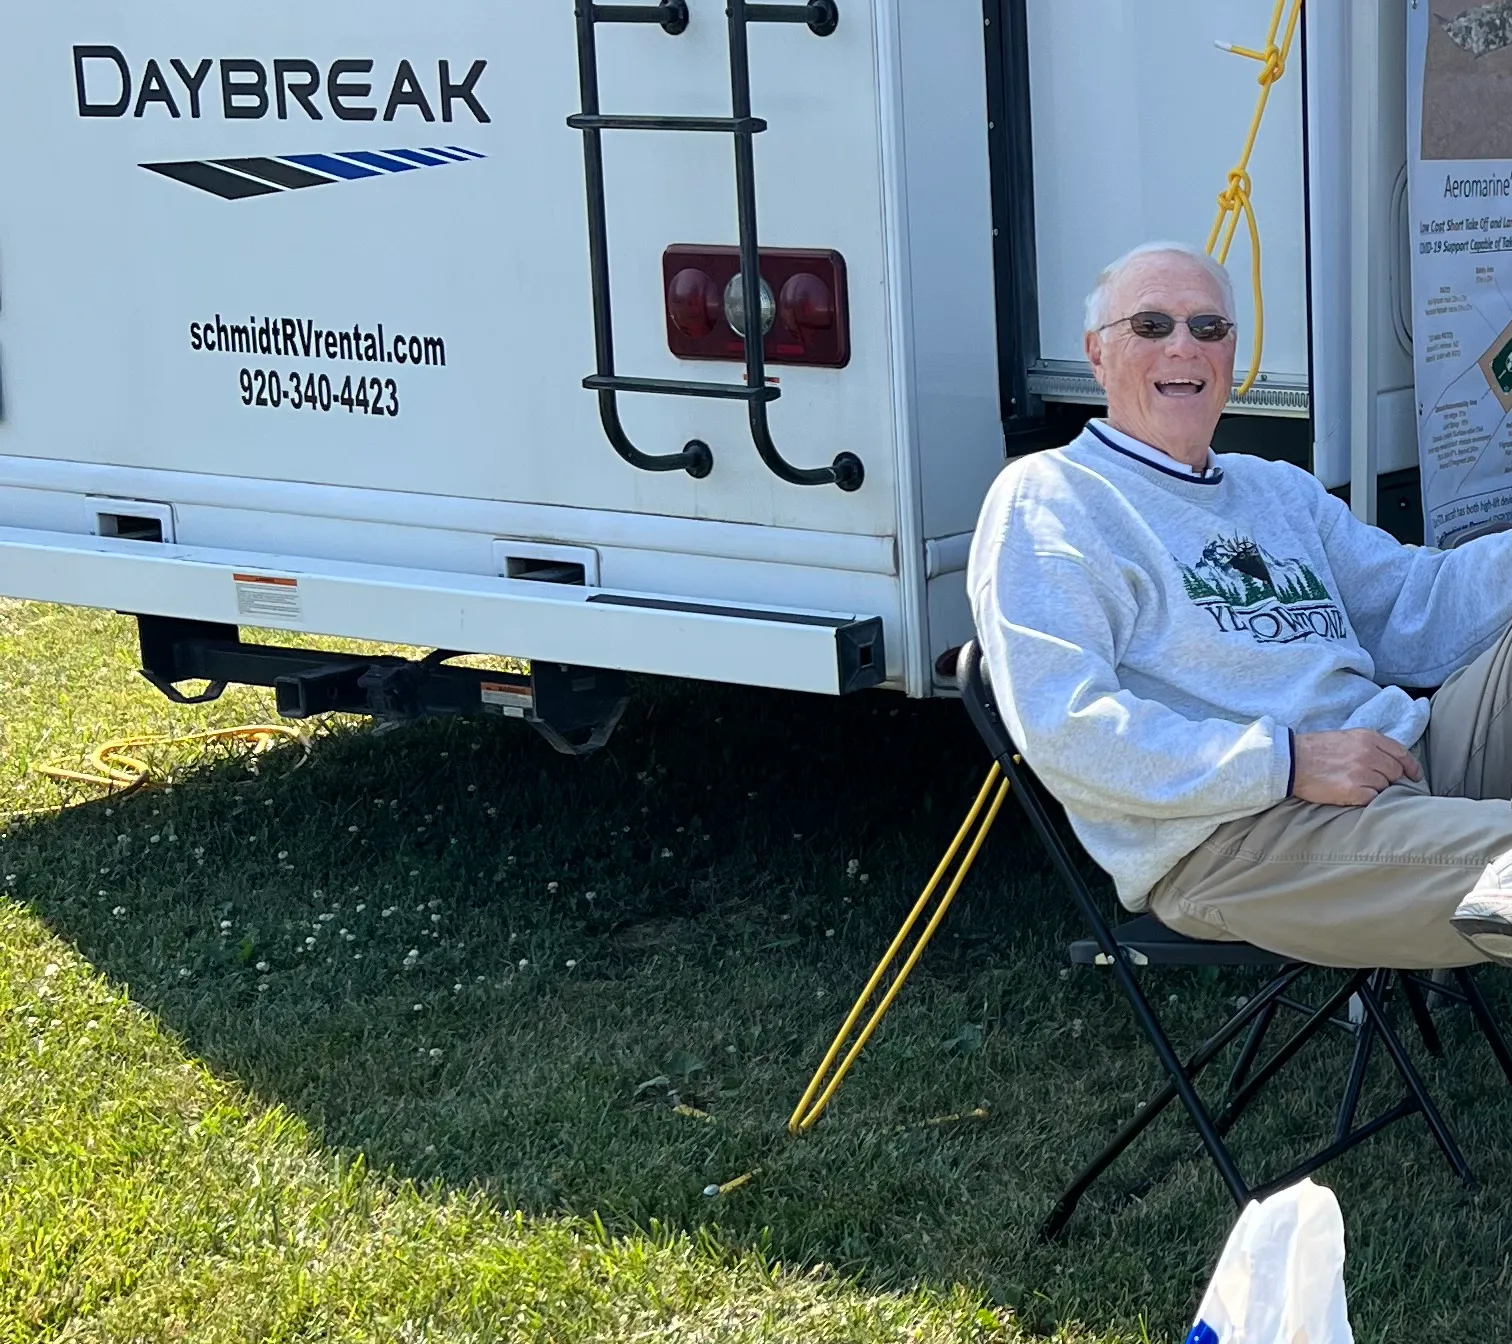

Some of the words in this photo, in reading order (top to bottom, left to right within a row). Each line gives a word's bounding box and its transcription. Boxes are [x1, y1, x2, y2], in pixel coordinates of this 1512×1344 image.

[1446, 218, 1464, 231] Short
[1465, 218, 1479, 230] Take
[1490, 216, 1502, 229] and
[1443, 240, 1470, 254] Support
[189, 313, 447, 366] schmidtRVrental.com
[239, 368, 400, 417] 920-340-4423
